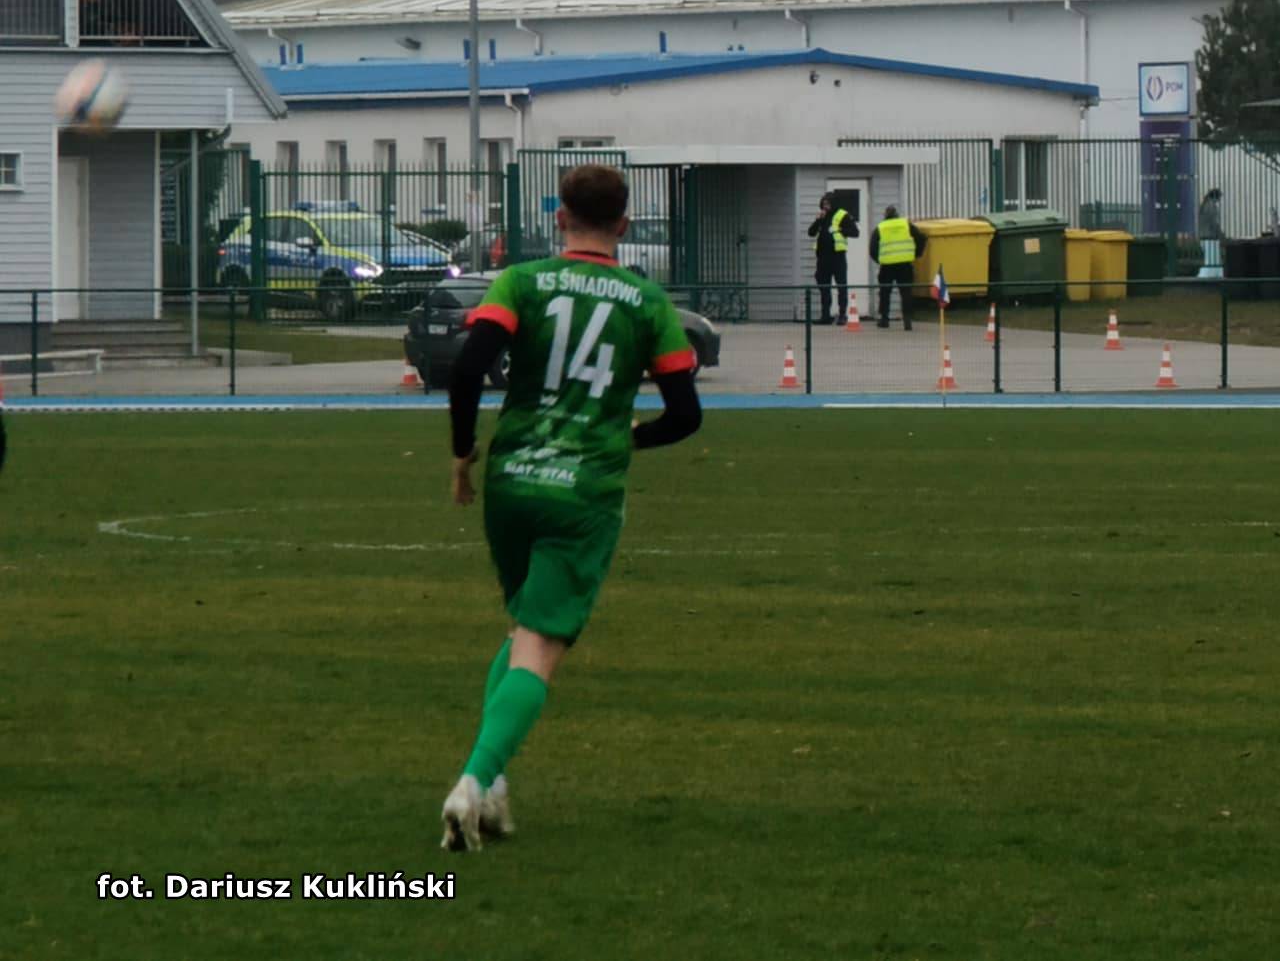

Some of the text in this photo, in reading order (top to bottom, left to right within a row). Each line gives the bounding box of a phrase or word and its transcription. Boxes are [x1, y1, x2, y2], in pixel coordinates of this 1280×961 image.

[536, 268, 642, 307] KS ŚNIADOWO
[545, 295, 614, 398] 14
